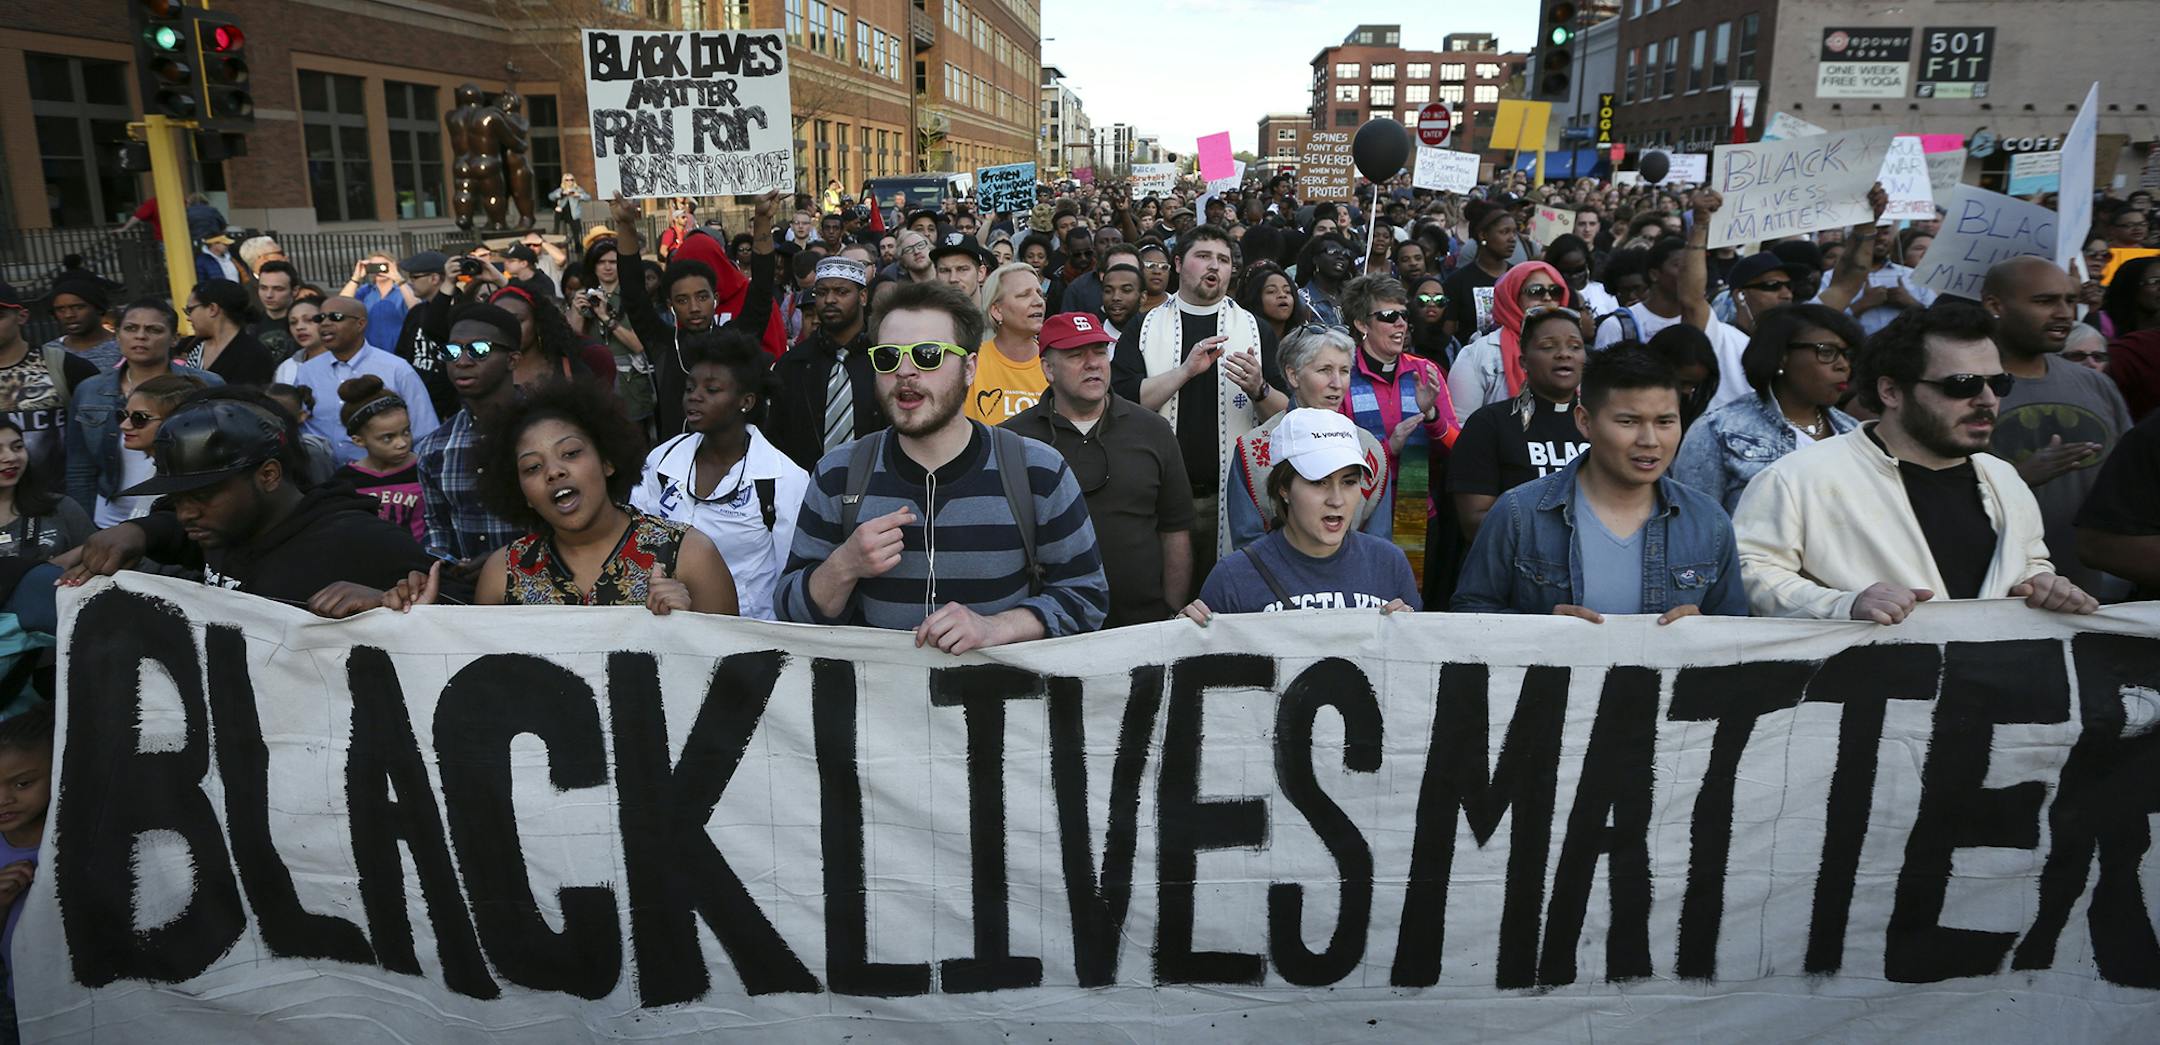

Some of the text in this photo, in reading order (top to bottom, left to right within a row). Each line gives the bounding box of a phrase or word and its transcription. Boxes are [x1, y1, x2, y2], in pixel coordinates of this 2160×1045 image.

[1930, 32, 1985, 54] 501
[588, 32, 783, 81] BLACK LIVES
[1826, 65, 1900, 75] ONE WEEK
[1822, 76, 1901, 86] FREE YOGA
[626, 78, 741, 110] MATTER
[1600, 95, 1613, 142] YOGA
[1312, 133, 1348, 142] SPINES
[1423, 130, 1443, 138] ENTER
[1335, 144, 1351, 152] GET
[2002, 138, 2061, 151] COFF
[1302, 153, 1354, 166] SEVERED
[1723, 138, 1848, 192] BLACK
[1331, 167, 1346, 175] YOU
[1301, 176, 1328, 185] SERVE
[1307, 186, 1350, 198] PROTECT
[1727, 201, 1838, 240] MATTER
[1957, 200, 2052, 250] BLAC
[1925, 264, 1986, 293] MAT
[368, 490, 418, 508] EON
[55, 583, 2160, 1008] BLACK LIVES MATTER
